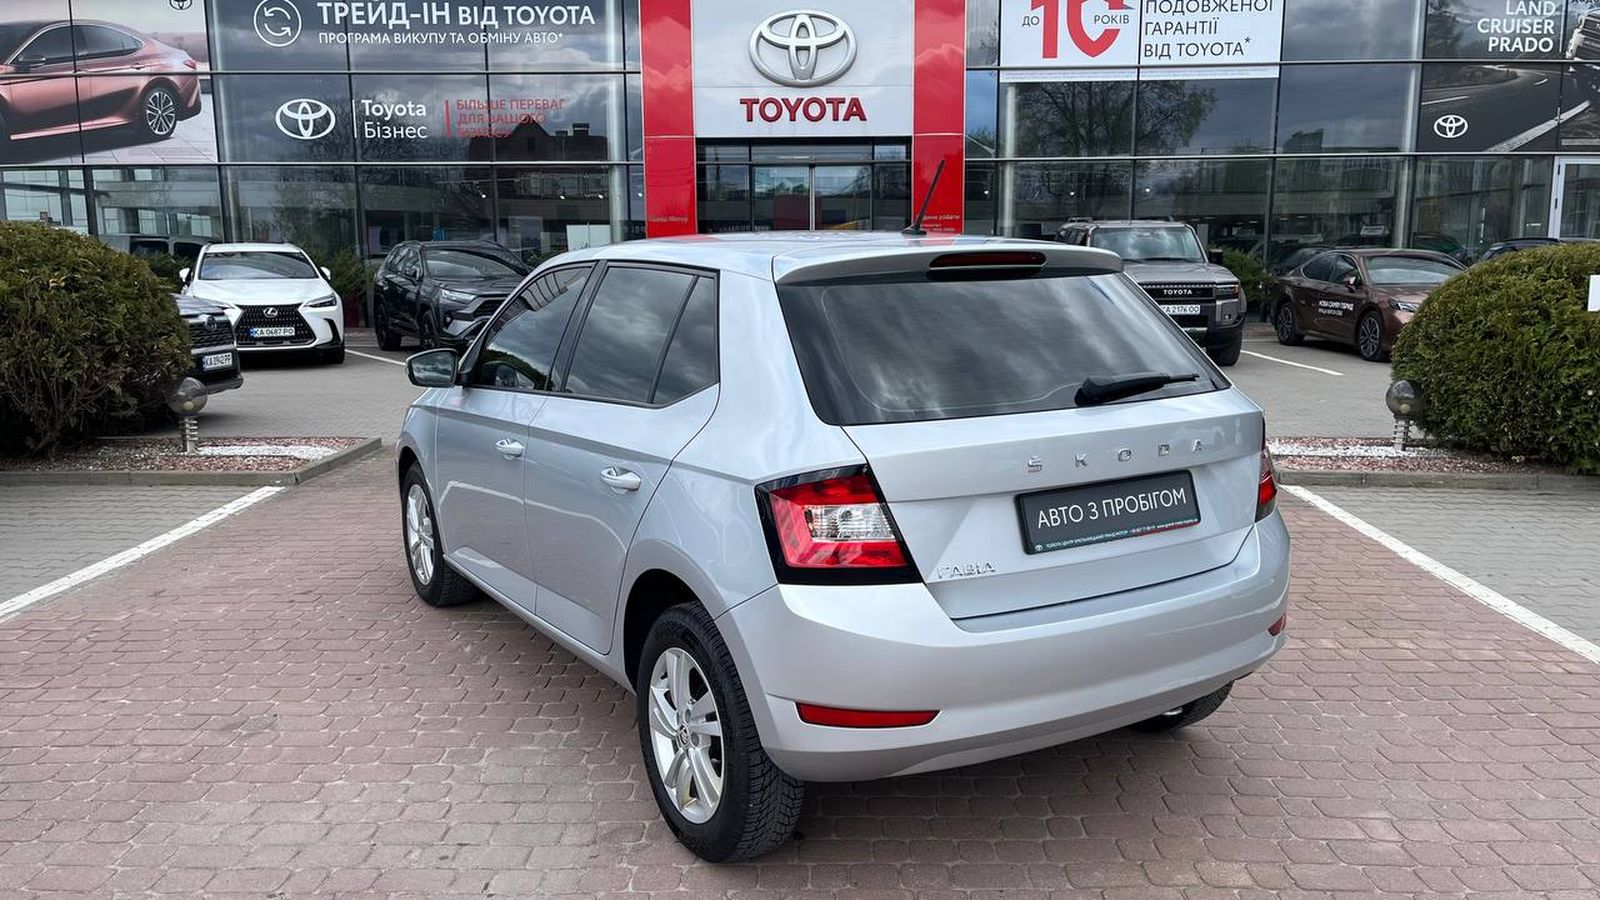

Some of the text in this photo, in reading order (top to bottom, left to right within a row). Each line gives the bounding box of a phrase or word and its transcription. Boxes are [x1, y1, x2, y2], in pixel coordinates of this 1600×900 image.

[317, 0, 596, 29] ТРЕЙД-ІН ВІД TOYOTA
[1506, 0, 1556, 16] LAND
[1022, 15, 1040, 27] ДО
[1094, 14, 1130, 25] РОКІВ
[1144, 16, 1220, 35] ГАРАНТІЇ
[1477, 18, 1555, 34] CRUISER
[319, 32, 391, 44] ПРОГРАМА
[394, 32, 447, 44] ВИКУПУ
[449, 32, 465, 44] ТА
[468, 32, 521, 44] ОБМІНУ
[1488, 36, 1554, 53] PRADO
[1144, 43, 1172, 60] ВІД
[361, 99, 427, 121] Toyota
[739, 97, 867, 123] TOYOTA
[364, 121, 429, 139] Бізнес
[1027, 439, 1203, 473] ŠKODA
[1038, 487, 1187, 529] АВТО З ПРОБІГОМ
[937, 562, 996, 580] FABIA
